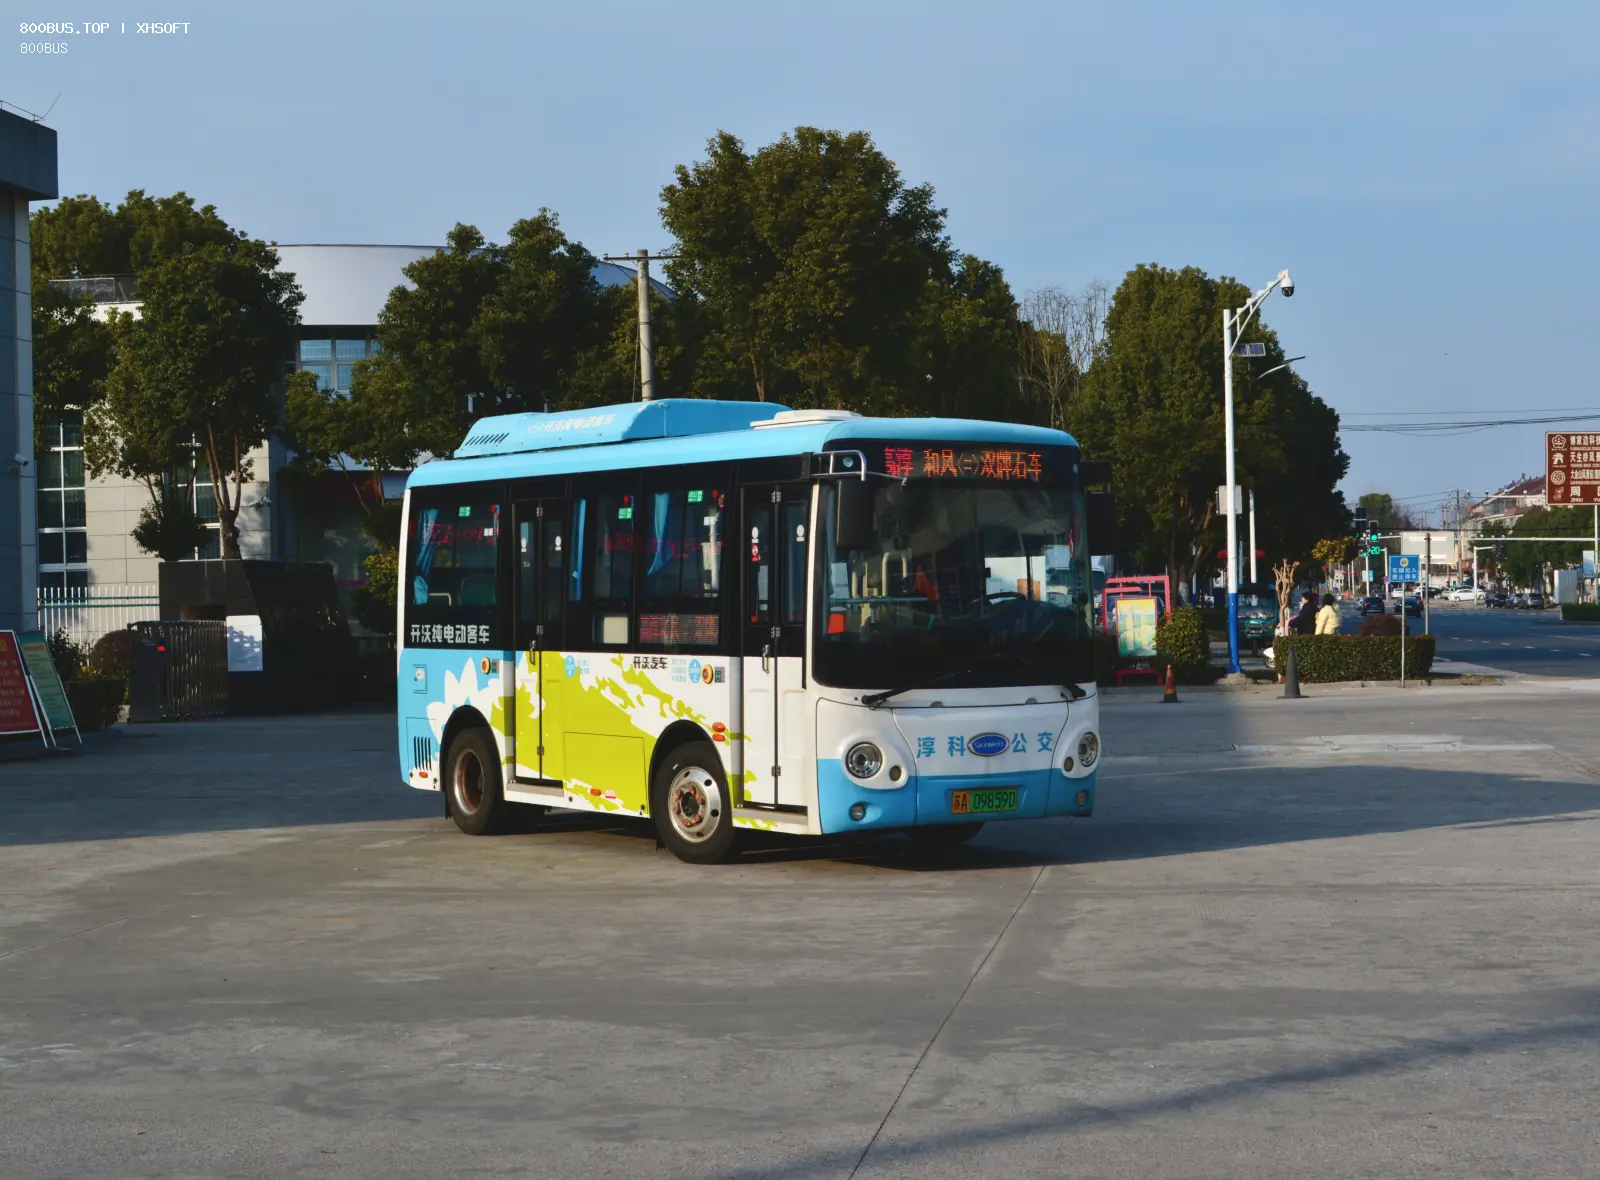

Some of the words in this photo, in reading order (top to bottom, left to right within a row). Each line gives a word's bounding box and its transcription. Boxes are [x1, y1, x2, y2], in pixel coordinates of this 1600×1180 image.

[1370, 546, 1381, 555] 20
[410, 624, 490, 644] 开沃纯电动客车
[633, 655, 668, 669] 开沃汽车
[916, 735, 966, 759] 淳科
[1011, 731, 1053, 753] 公交
